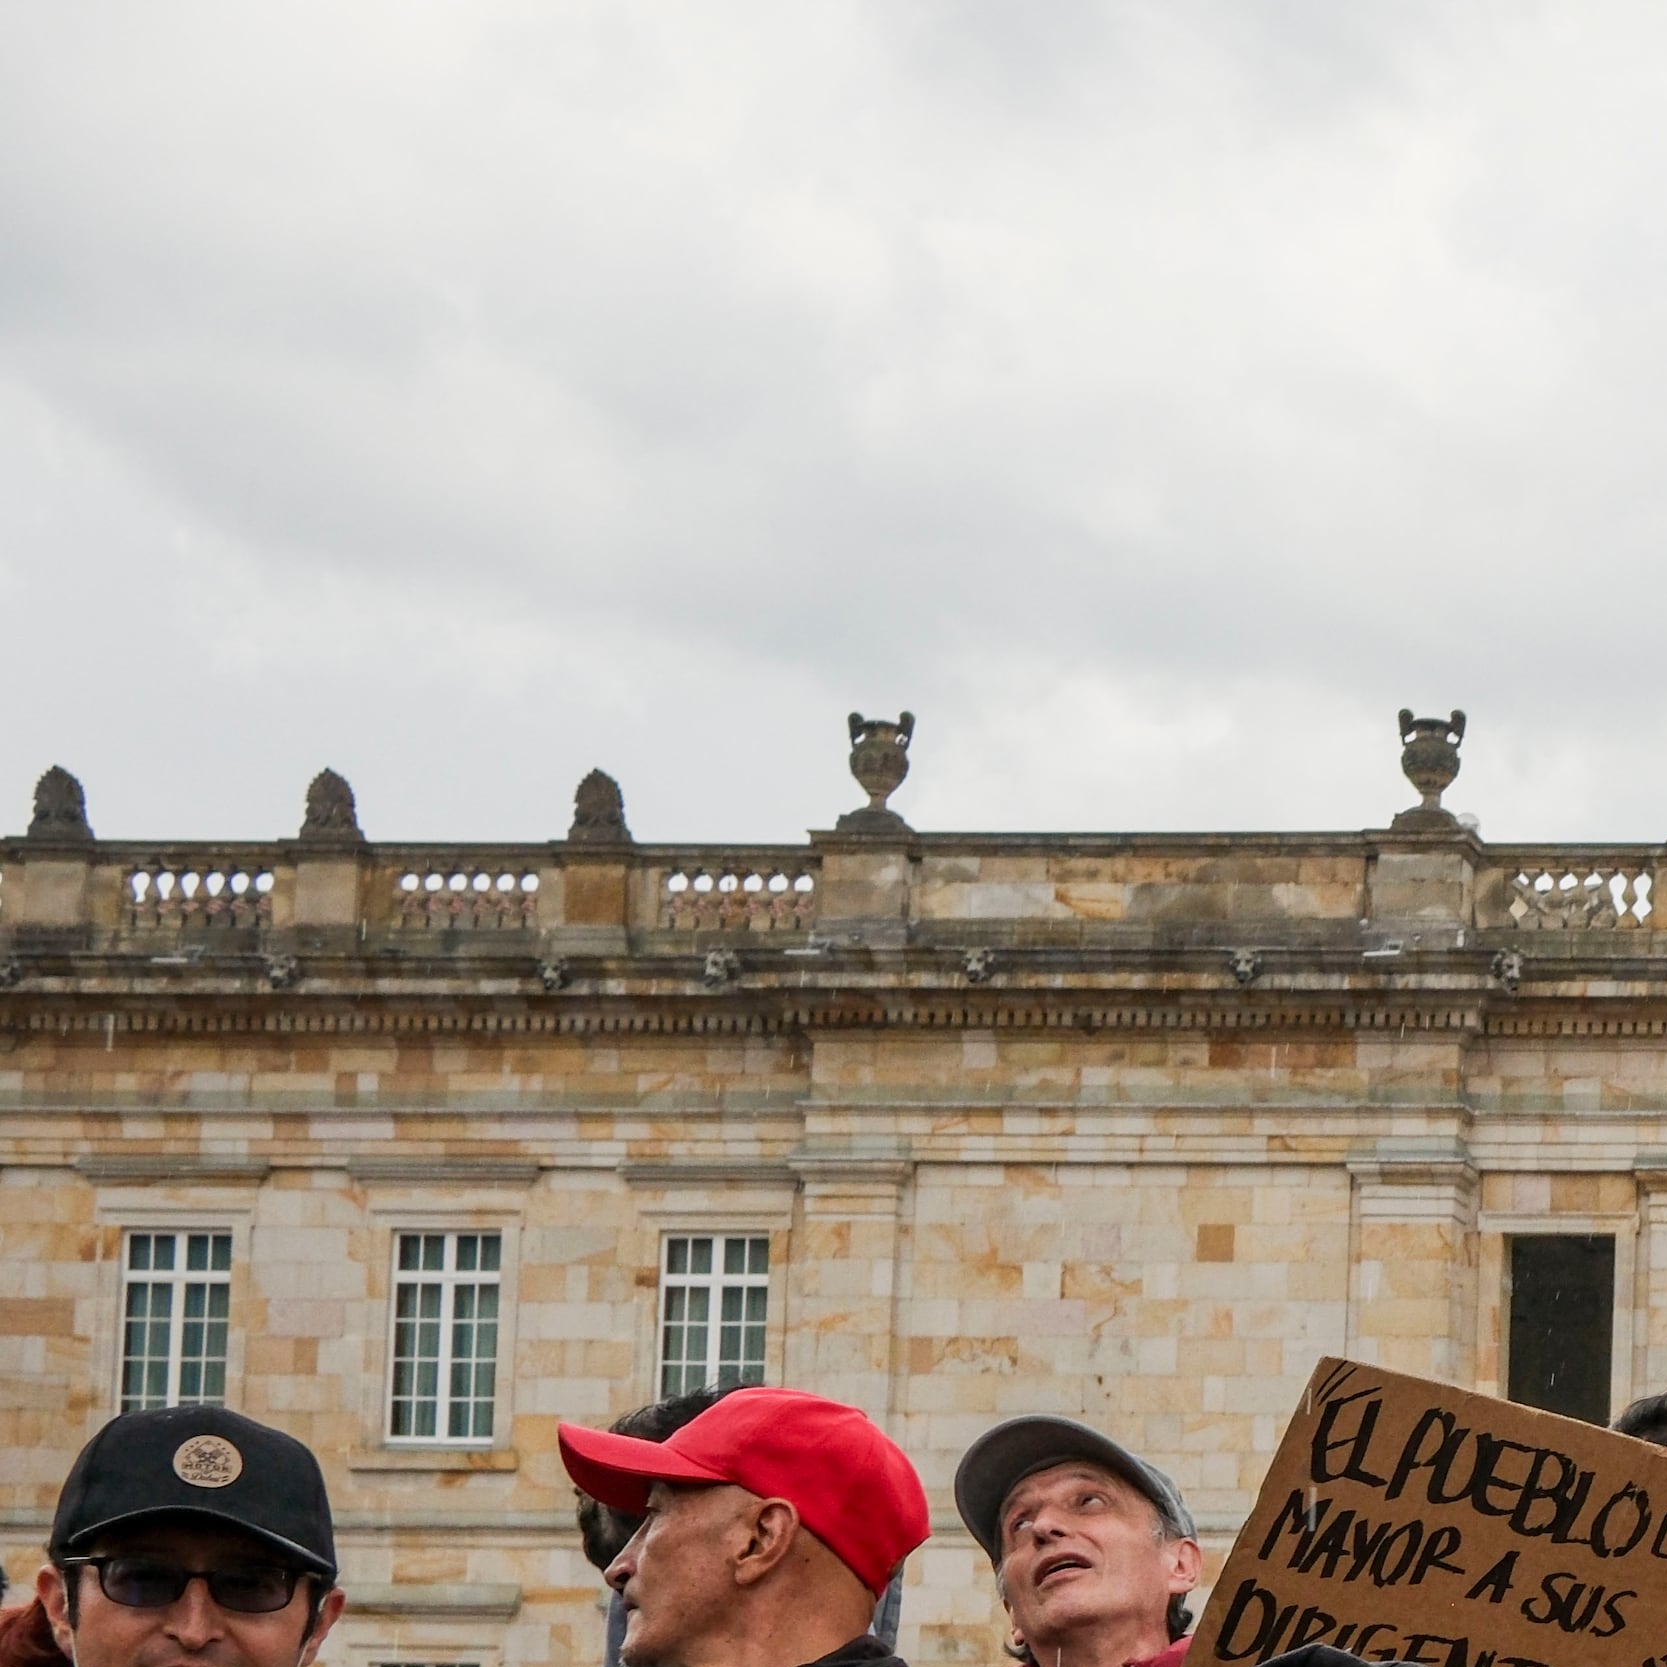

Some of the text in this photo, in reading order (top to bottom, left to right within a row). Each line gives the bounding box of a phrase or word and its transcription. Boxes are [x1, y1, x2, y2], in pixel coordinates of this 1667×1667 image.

[1385, 1406, 1654, 1559] PUEBLO
[1257, 1488, 1638, 1638] MAYOR A SUS
